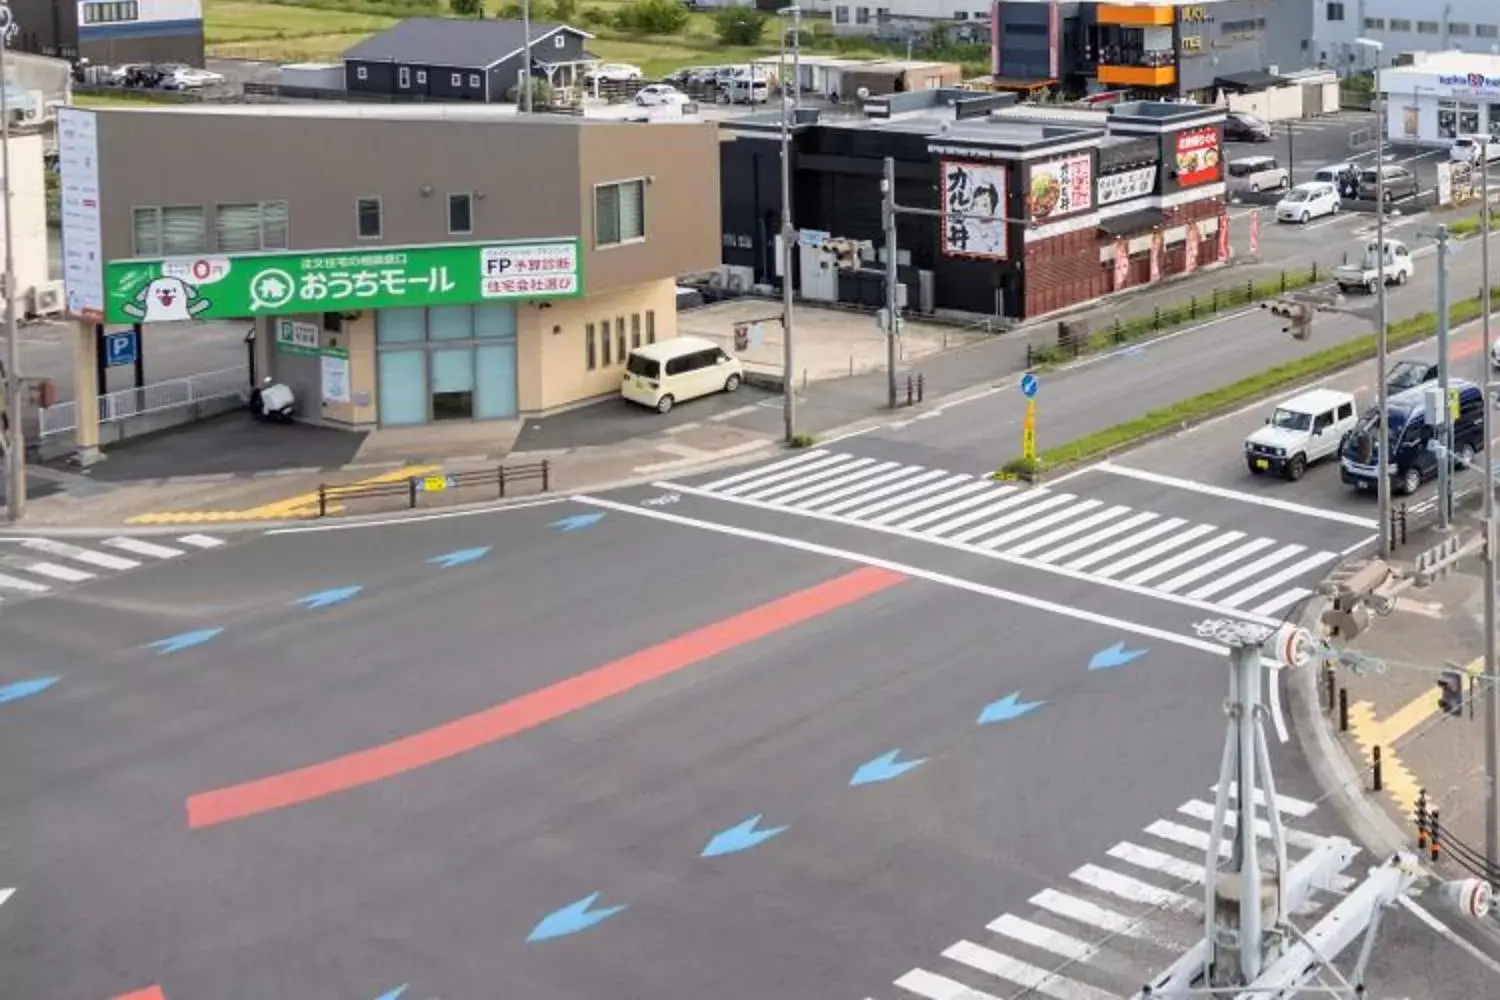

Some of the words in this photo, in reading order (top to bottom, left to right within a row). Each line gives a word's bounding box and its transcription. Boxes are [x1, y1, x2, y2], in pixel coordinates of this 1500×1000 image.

[486, 257, 511, 274] FP
[300, 265, 456, 300] おうちモール
[113, 337, 129, 356] P
